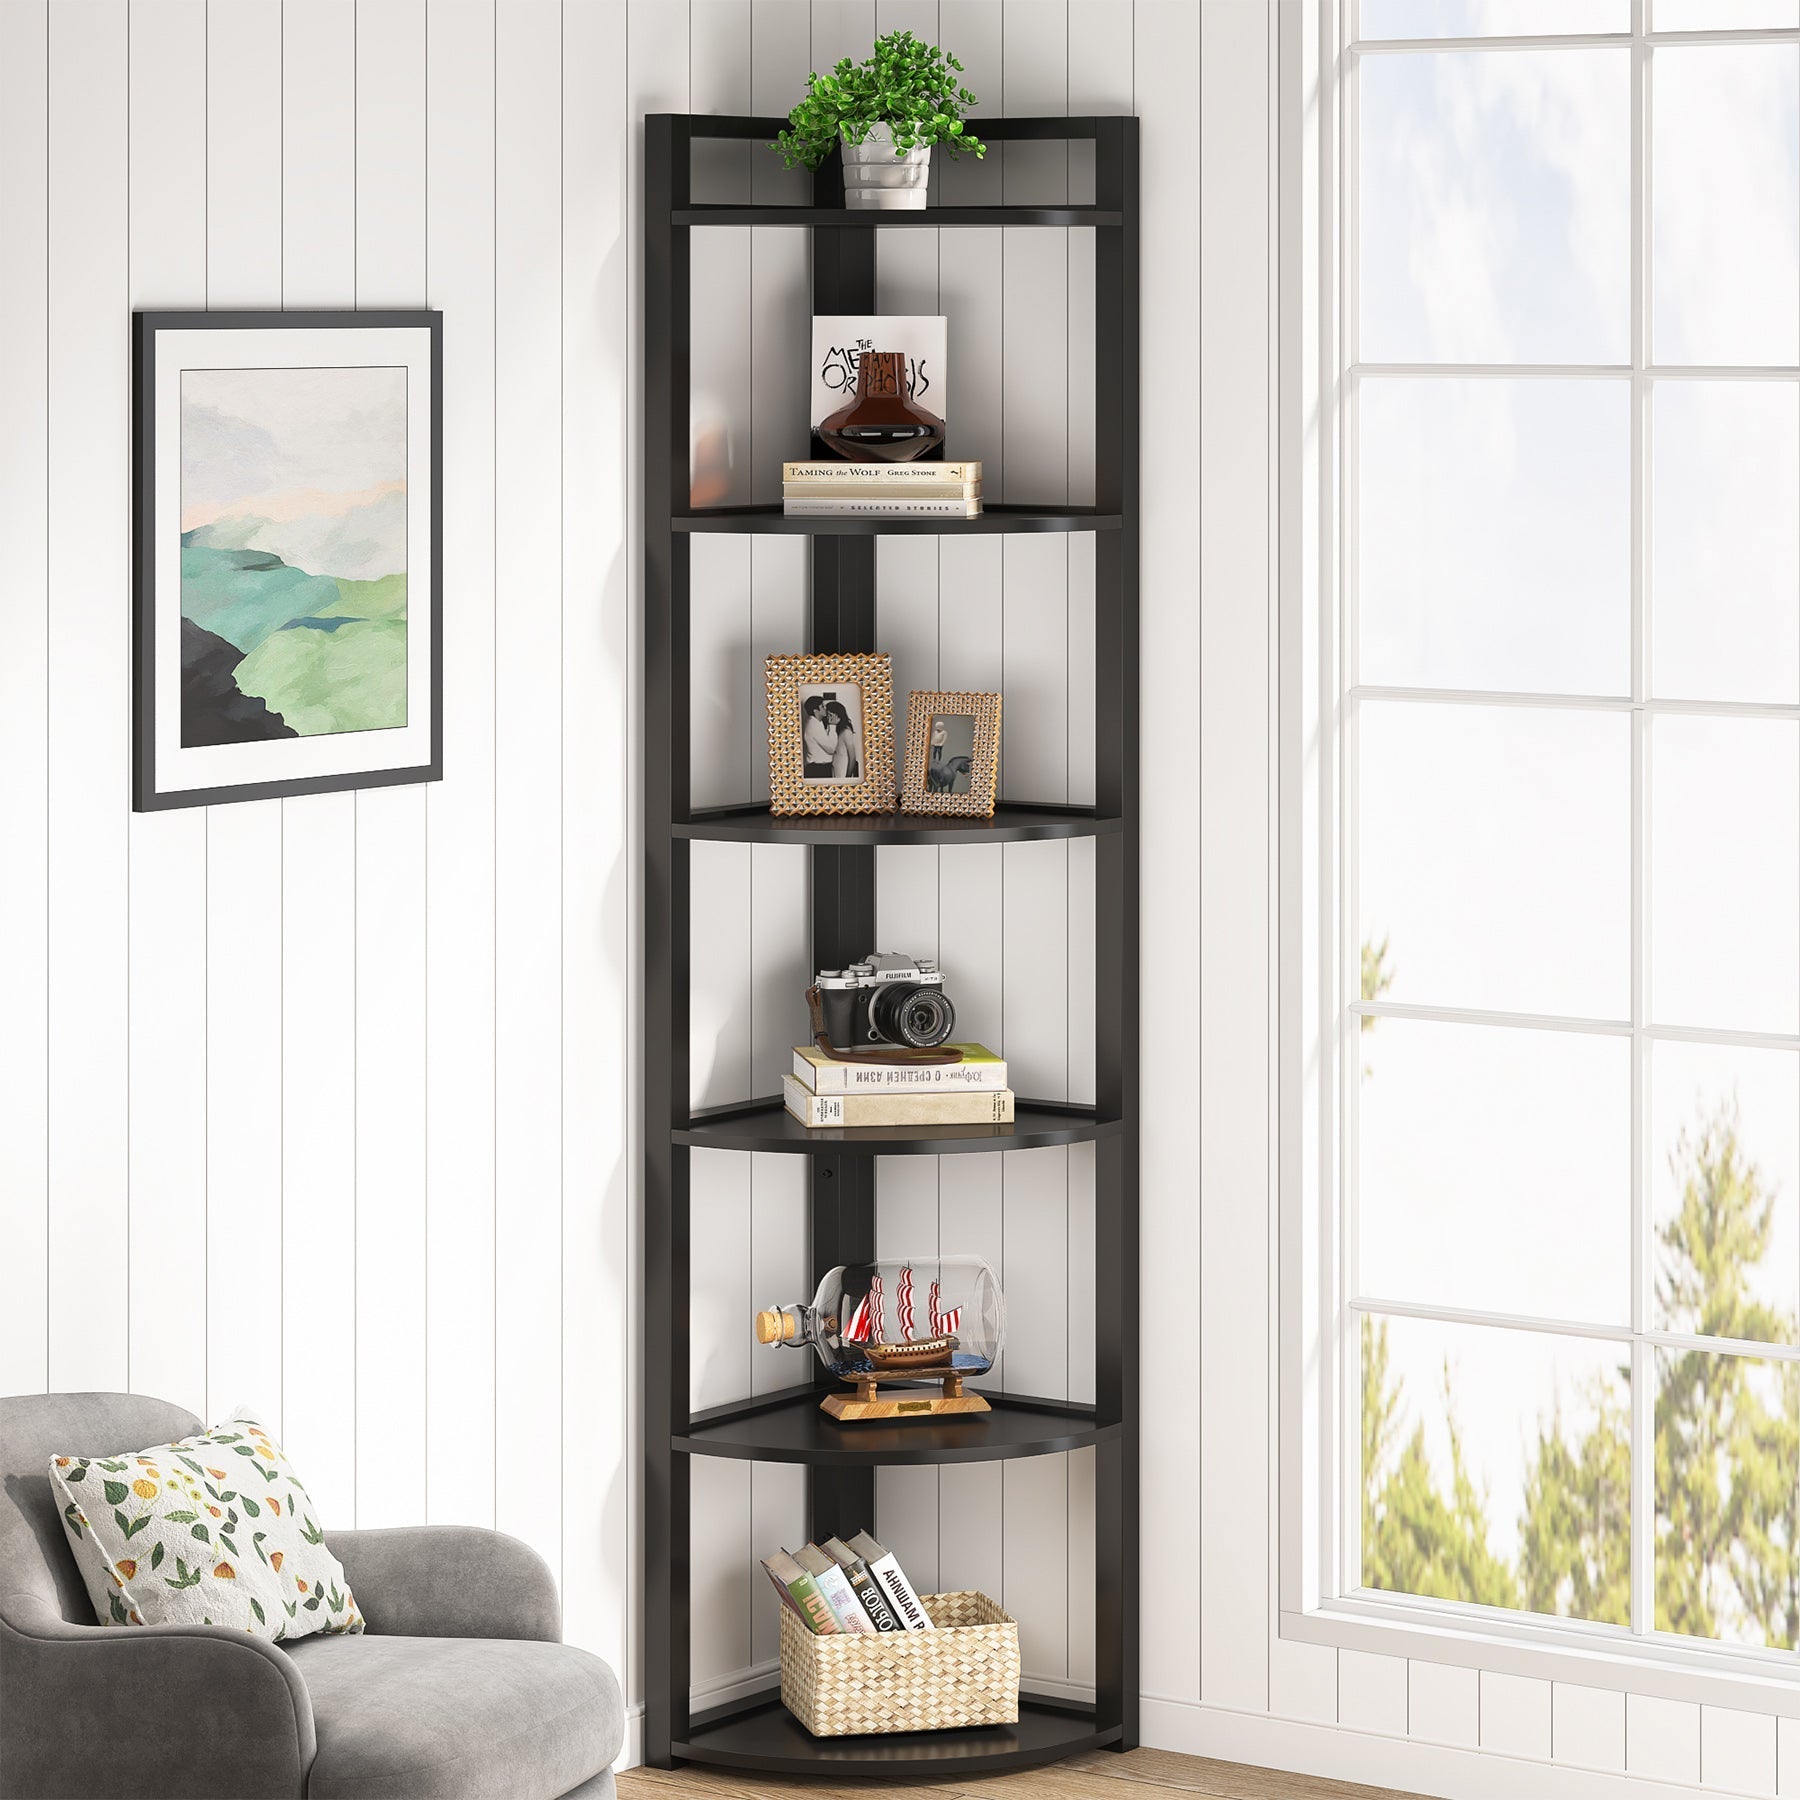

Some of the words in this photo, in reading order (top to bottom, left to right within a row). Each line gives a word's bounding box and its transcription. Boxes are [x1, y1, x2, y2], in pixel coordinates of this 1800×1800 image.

[856, 339, 873, 351] THE
[789, 467, 833, 476] TAMING
[849, 468, 881, 476] WOLF
[885, 971, 912, 980] FUJIFILM
[856, 1071, 883, 1083] АЗИИ
